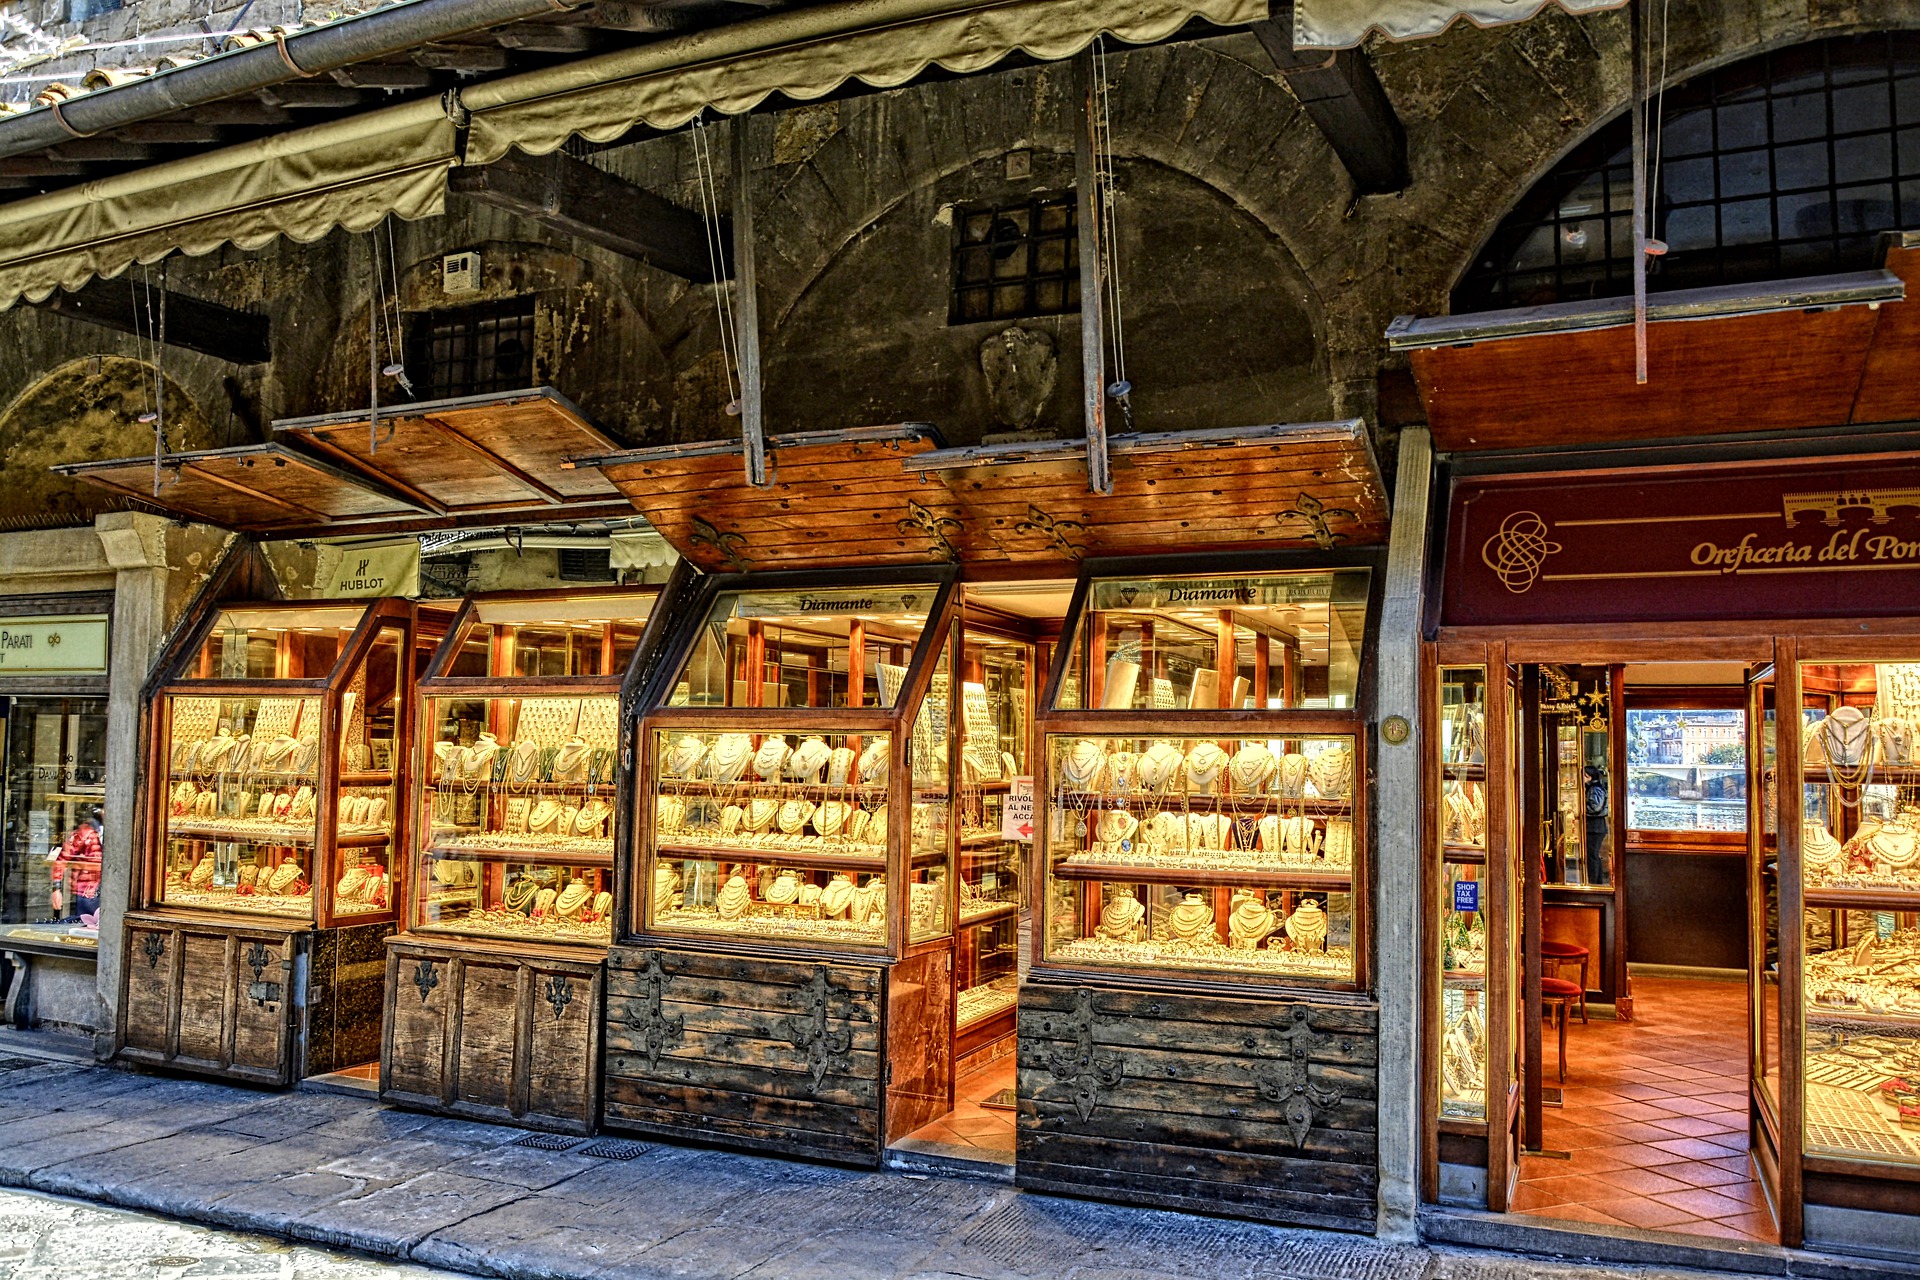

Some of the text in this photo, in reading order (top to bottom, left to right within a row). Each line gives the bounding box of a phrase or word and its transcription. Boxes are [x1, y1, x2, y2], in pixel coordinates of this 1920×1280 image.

[1690, 532, 1813, 573] Oreficeria
[1817, 528, 1870, 562] del
[340, 578, 384, 591] HUBLOT
[1168, 586, 1257, 602] Diamante
[800, 599, 873, 611] Diamante
